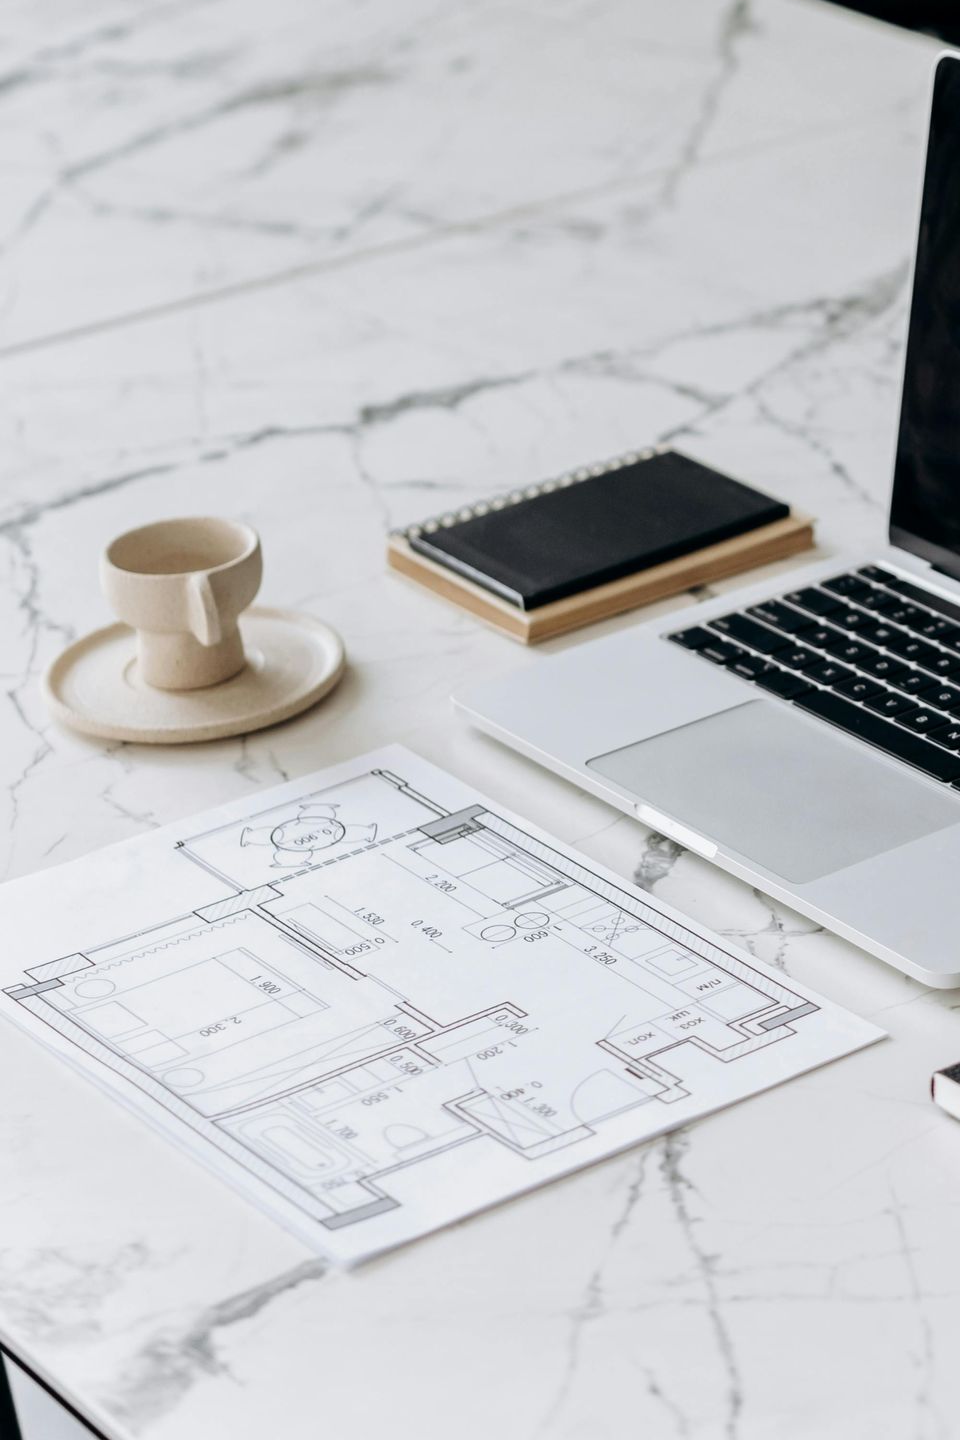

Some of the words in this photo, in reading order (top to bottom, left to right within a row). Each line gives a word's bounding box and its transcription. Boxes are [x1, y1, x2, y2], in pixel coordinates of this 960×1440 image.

[948, 731, 960, 740] N
[425, 874, 457, 893] 2.200
[353, 907, 385, 926] 1.530
[410, 919, 443, 939] 0.400
[523, 925, 562, 943] 1.600
[344, 937, 385, 956] 0.500
[583, 945, 617, 965] 3.250
[250, 975, 281, 994] 1.900
[199, 1016, 242, 1037] 2.300
[383, 1019, 417, 1039] 0.600
[495, 1014, 529, 1035] 0.300
[476, 1041, 518, 1061] 1.200
